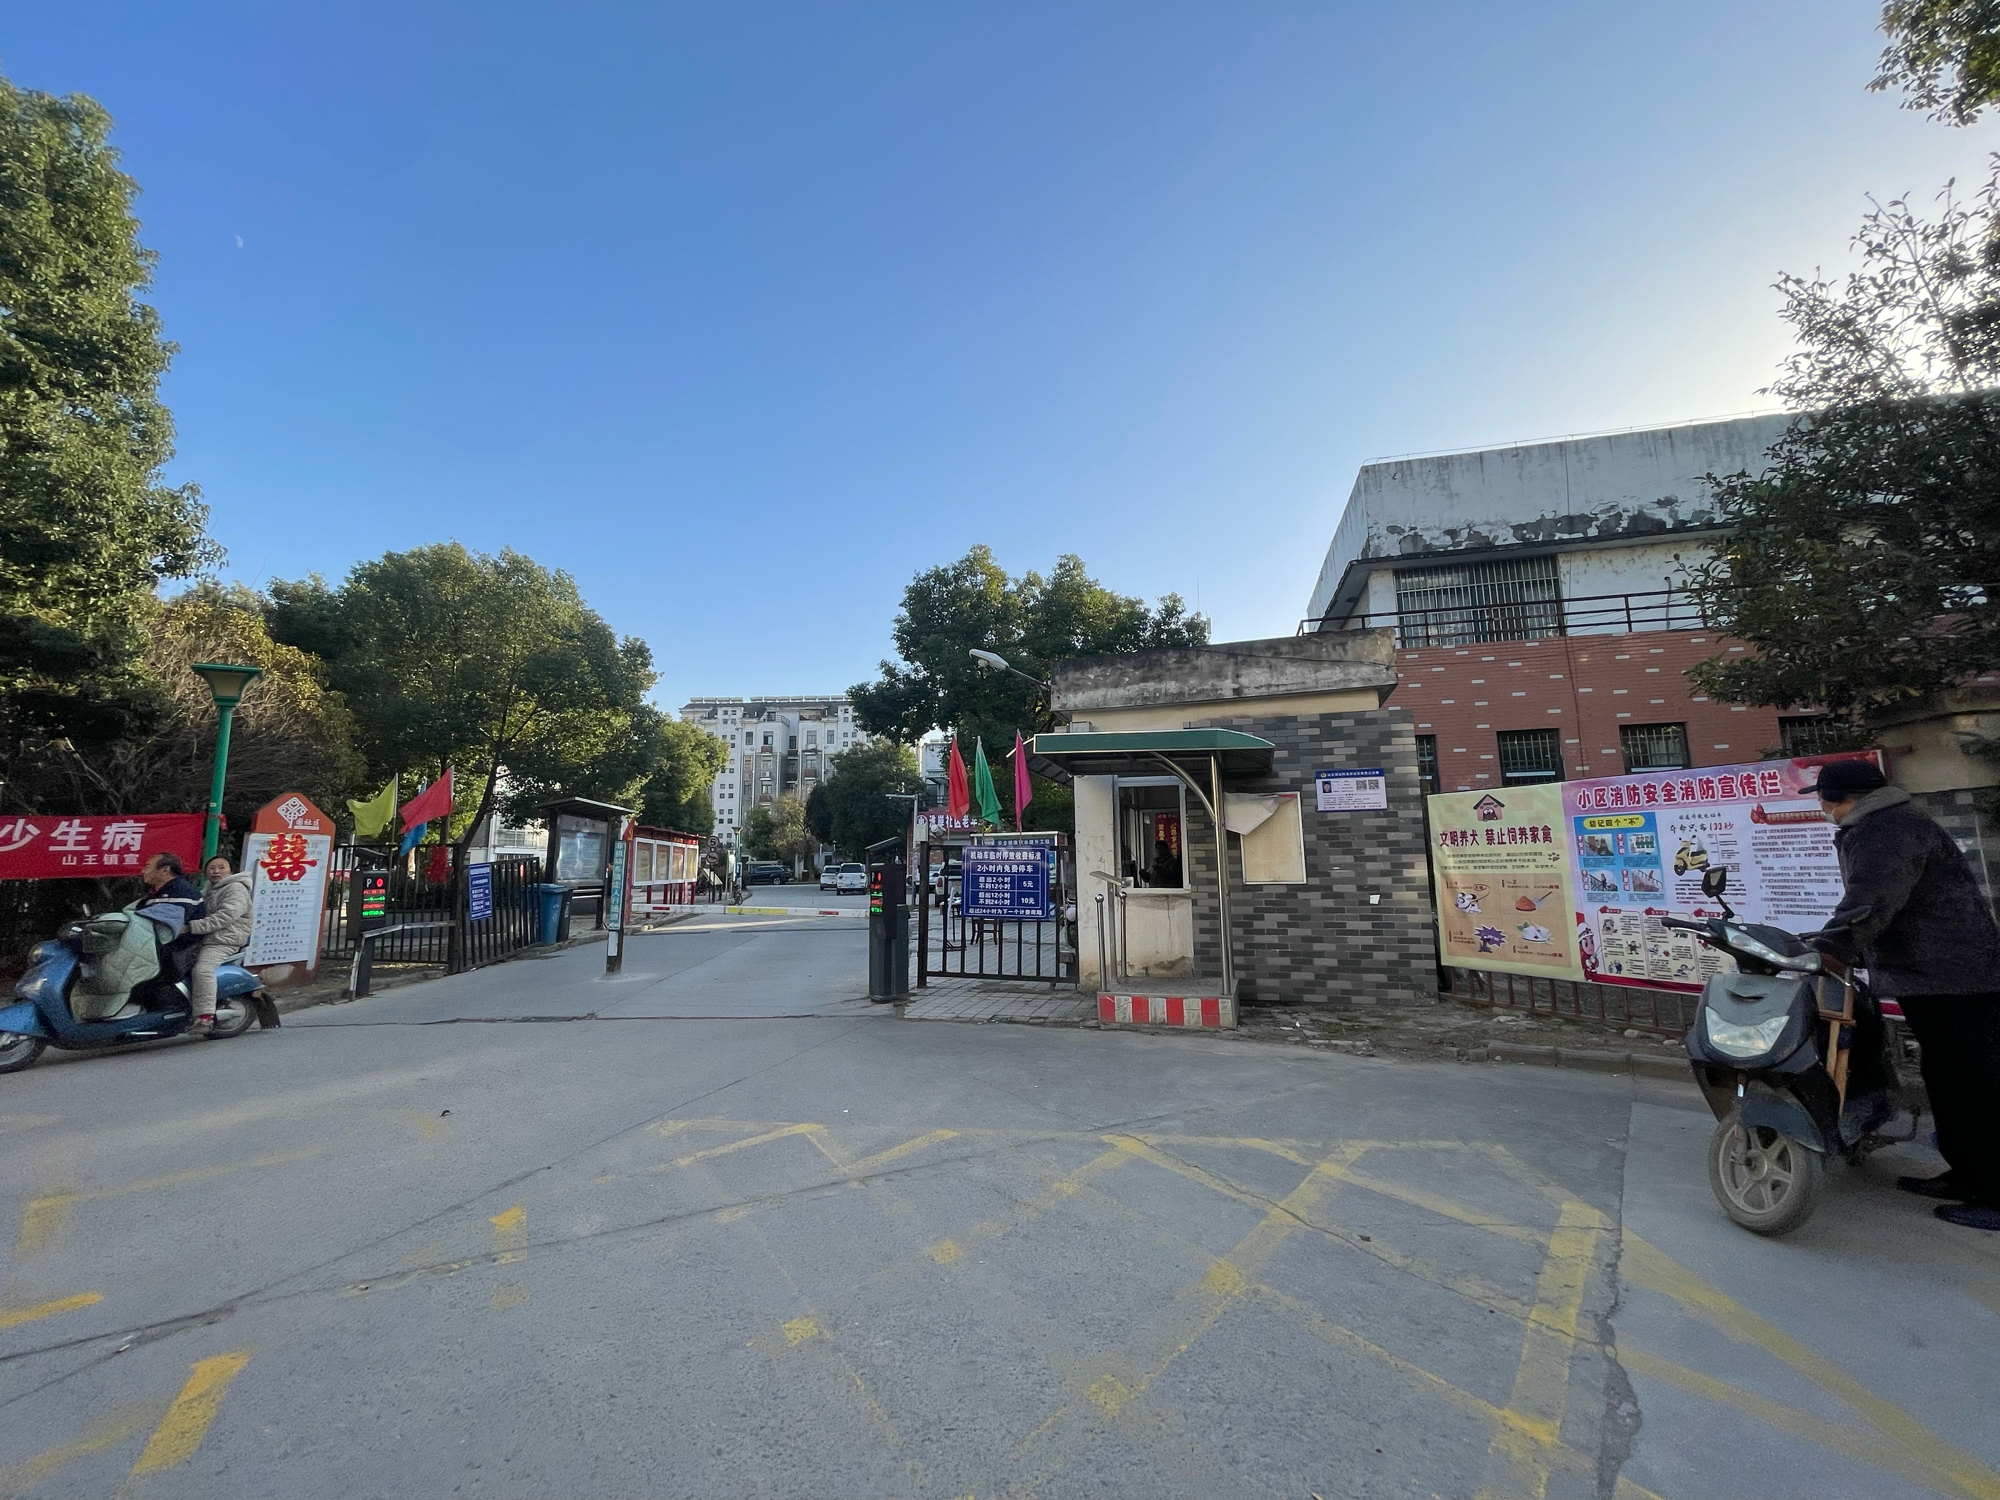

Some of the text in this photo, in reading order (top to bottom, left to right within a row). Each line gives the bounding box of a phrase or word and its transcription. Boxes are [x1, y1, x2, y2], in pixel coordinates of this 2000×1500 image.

[1578, 772, 1781, 810] 小区消防安全消防宣传栏
[0, 819, 147, 852] 少生病
[1440, 824, 1553, 847] 文明养犬 禁止饲养家禽
[709, 838, 716, 846] 5
[62, 853, 139, 866] 山王镇宣
[970, 851, 1041, 860] 机动车临时停放收费标准
[977, 864, 1033, 873] 2小时内免费停车
[366, 878, 372, 888] P
[969, 908, 1042, 916] 超过24小时为下一个计费周期
